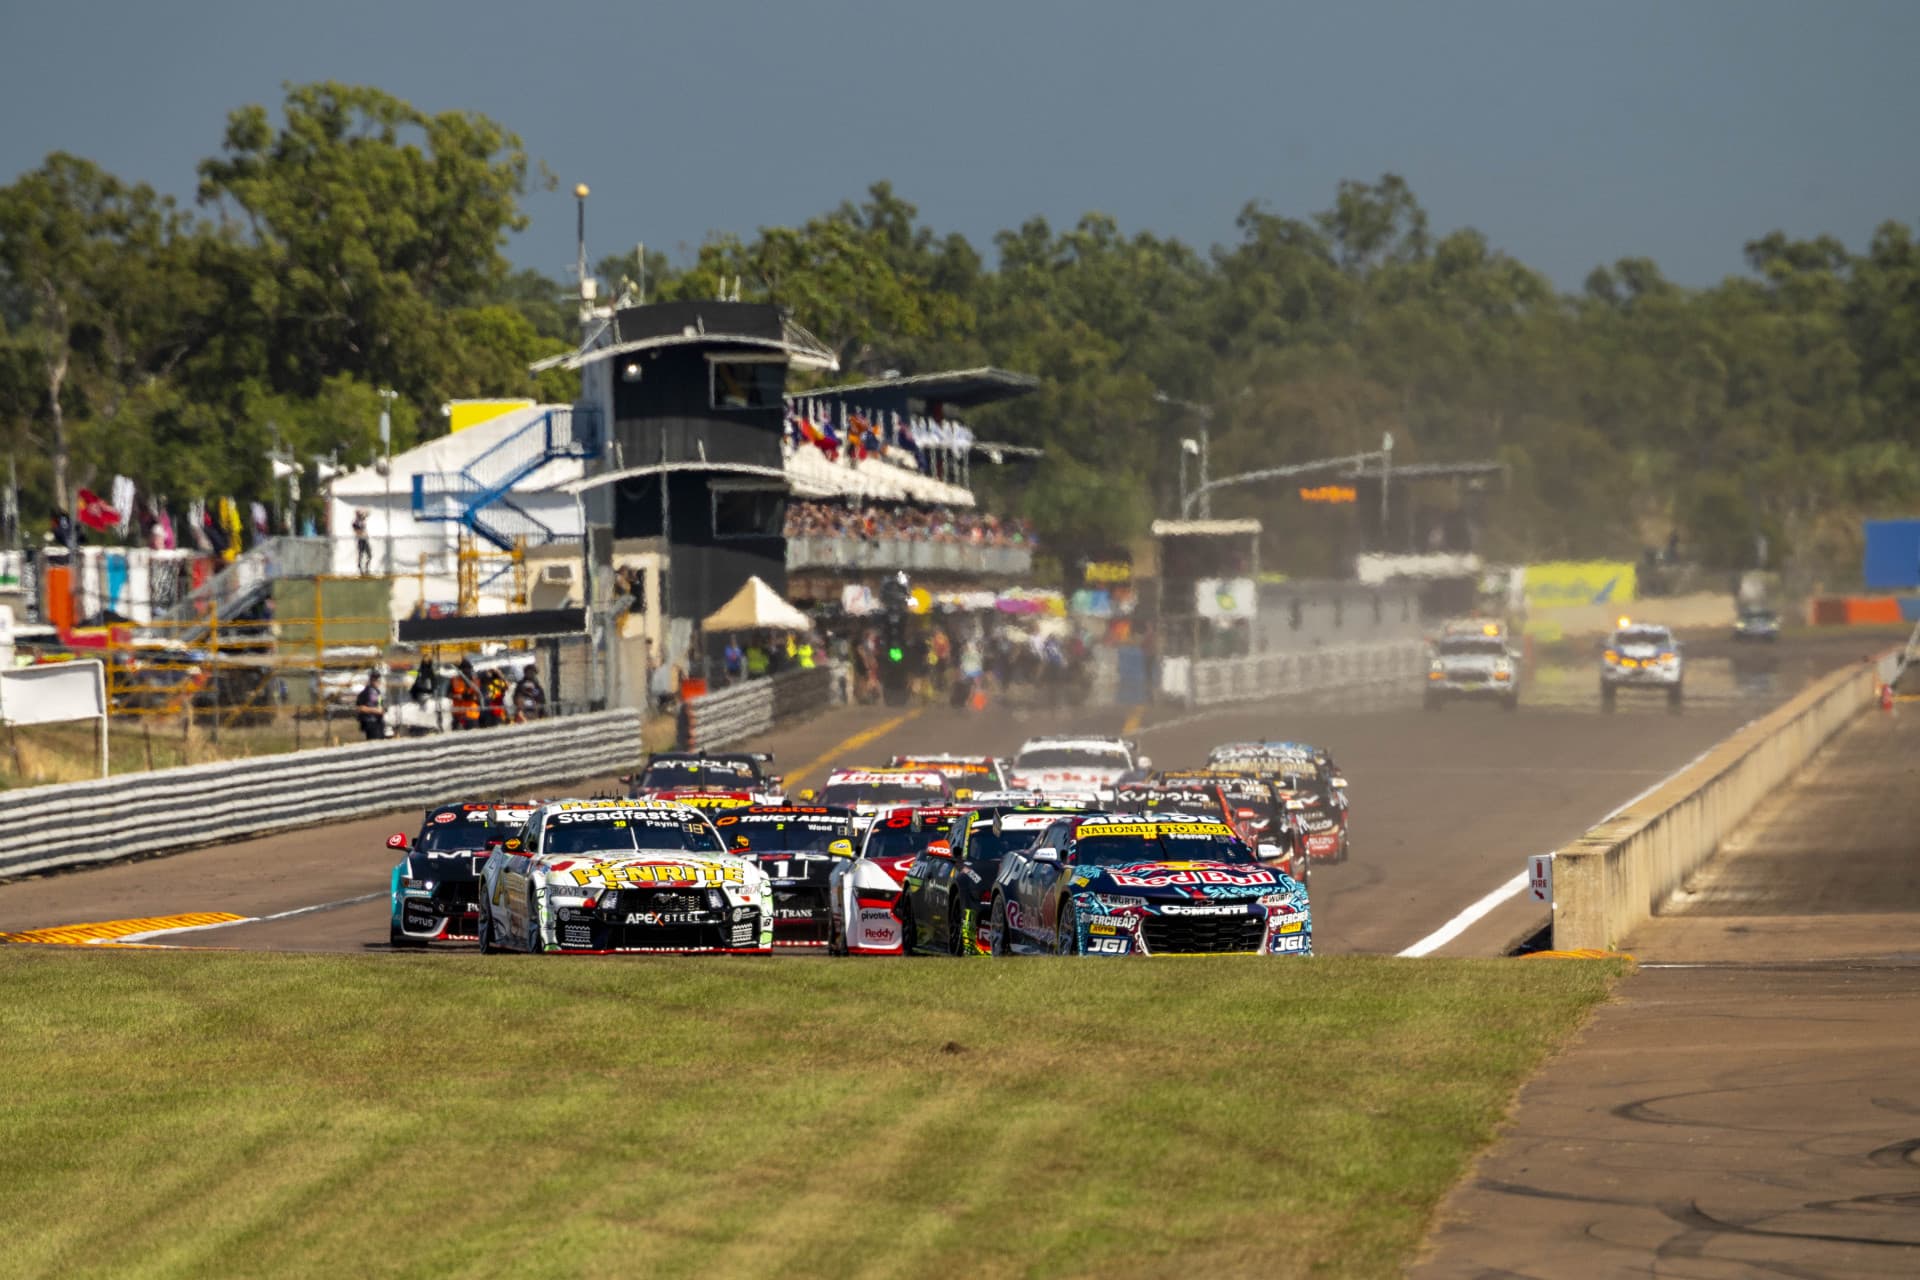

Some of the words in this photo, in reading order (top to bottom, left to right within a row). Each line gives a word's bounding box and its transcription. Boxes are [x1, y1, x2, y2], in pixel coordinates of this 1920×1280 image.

[1119, 789, 1210, 803] Kubota
[558, 810, 670, 824] Steadfast
[1082, 813, 1221, 825] AMPOL
[646, 821, 679, 829] Payne
[808, 824, 833, 832] Wood
[1080, 824, 1153, 836] NATIONAL
[570, 864, 744, 887] PENRITE
[773, 861, 789, 877] 1
[1110, 871, 1200, 887] Red
[1200, 870, 1277, 885] Bull
[1531, 879, 1547, 888] FIRE
[625, 911, 664, 927] APEX
[665, 914, 700, 922] STEEL
[780, 908, 813, 917] TRANS
[408, 914, 434, 928] OPTUS
[1080, 912, 1137, 930] SUPERCHEAP
[865, 928, 894, 940] Reddy
[1087, 938, 1129, 953] JGI
[1275, 935, 1304, 951] JGI
